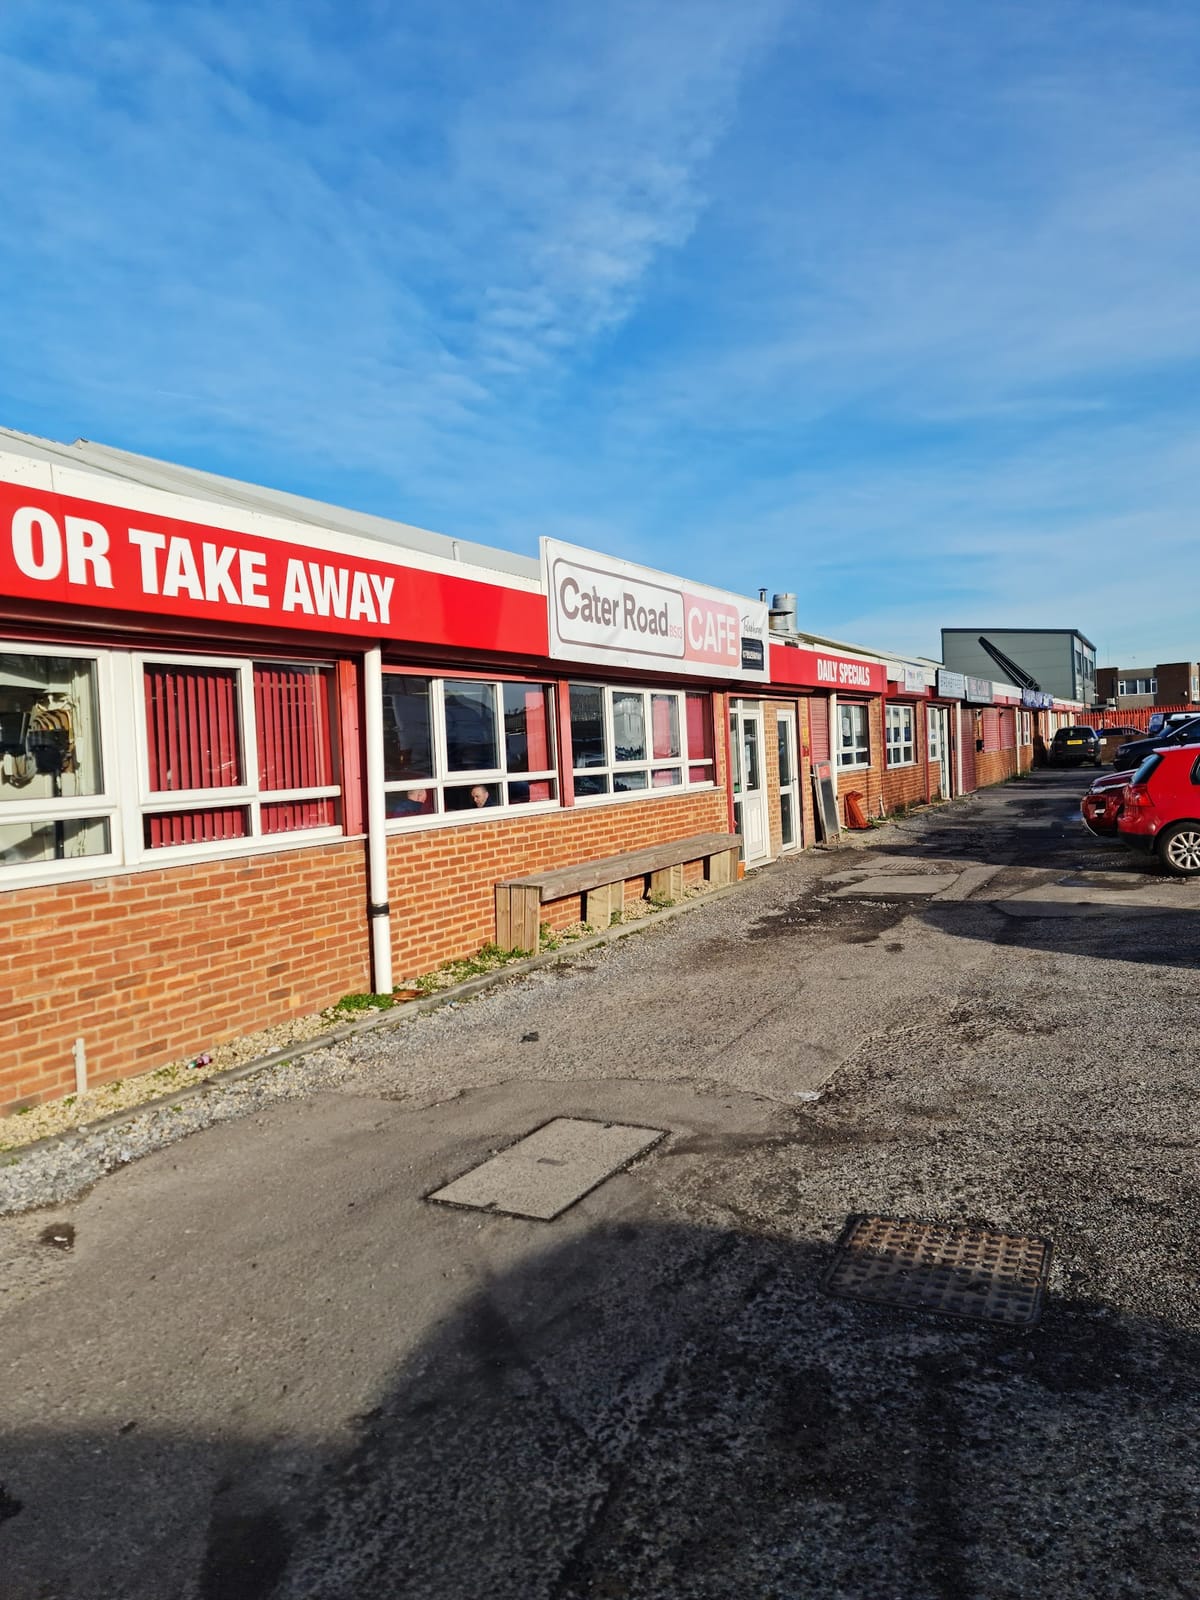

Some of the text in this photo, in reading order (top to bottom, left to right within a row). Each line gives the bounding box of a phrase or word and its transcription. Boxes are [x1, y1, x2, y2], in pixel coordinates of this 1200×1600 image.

[11, 506, 395, 624] OR TAKE AWAY
[560, 577, 669, 637] Cater Road
[688, 607, 737, 656] CAFE
[817, 658, 871, 687] DAILY SPECIALS
